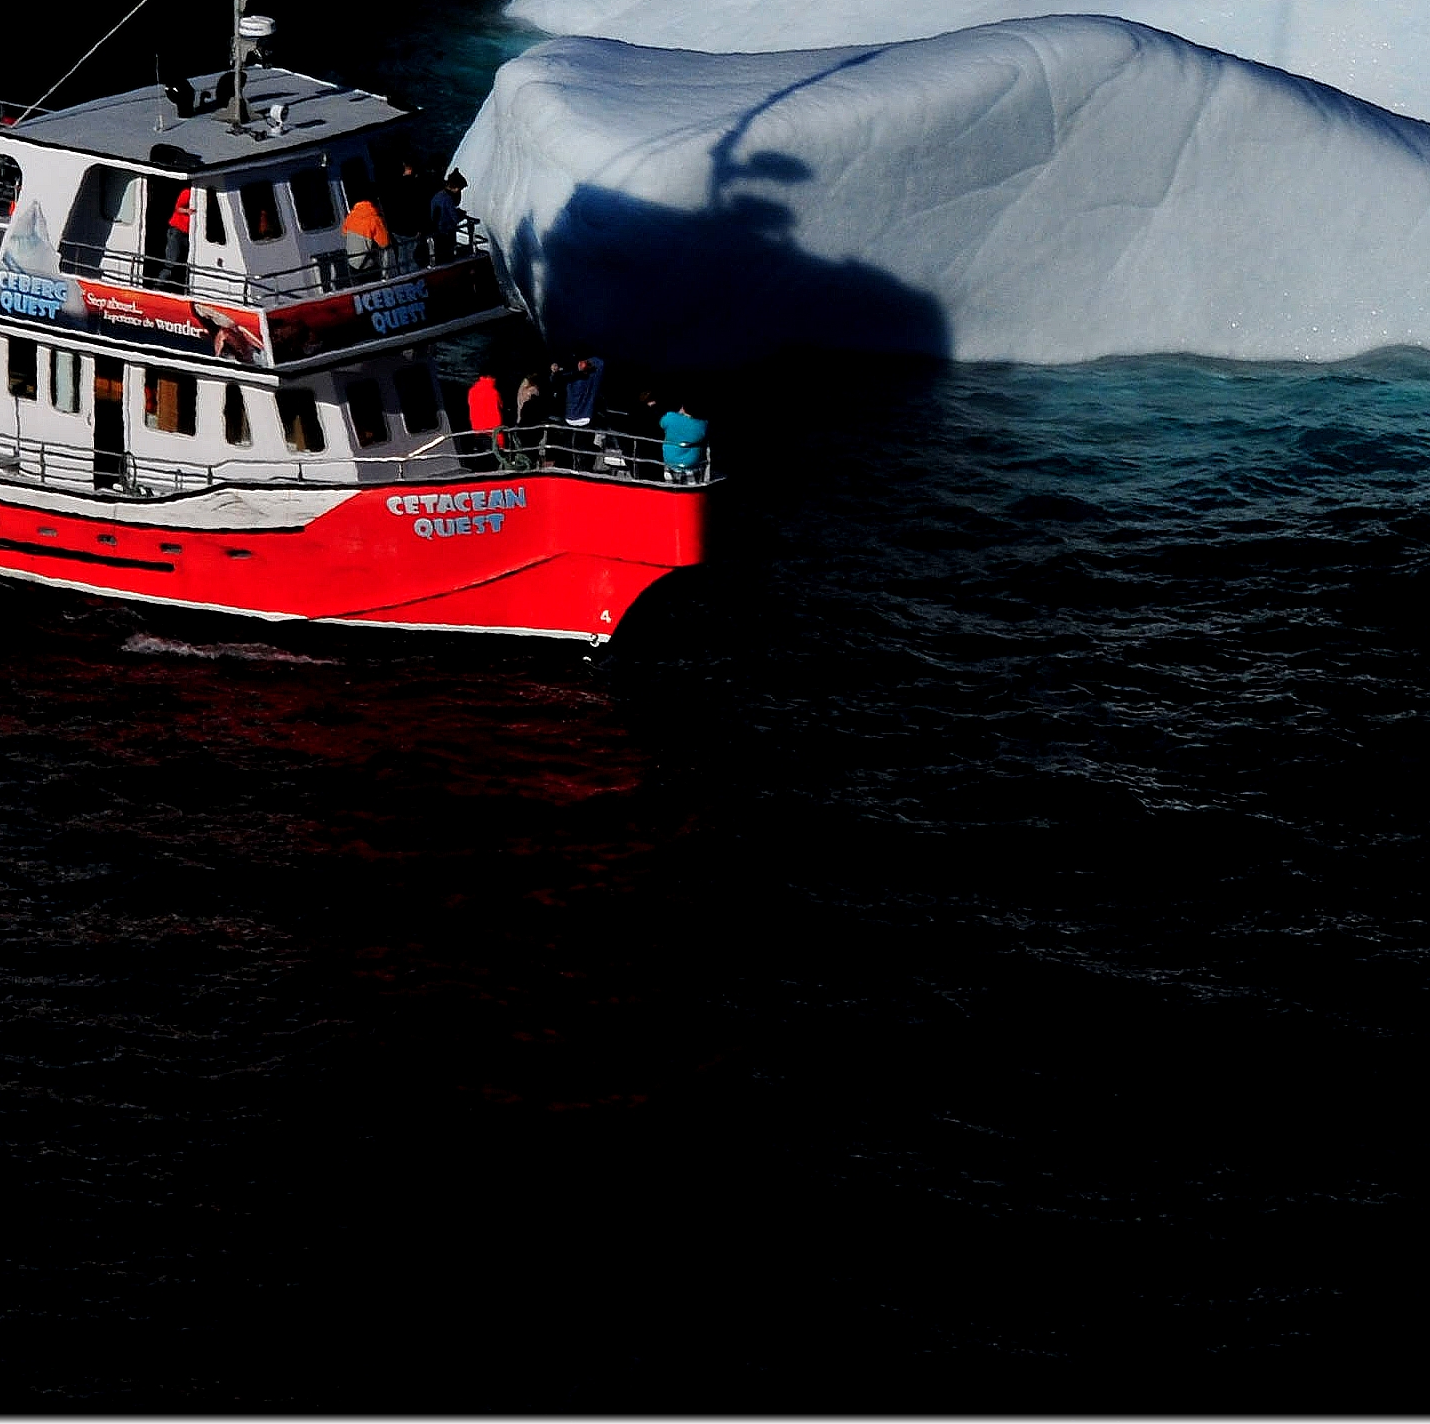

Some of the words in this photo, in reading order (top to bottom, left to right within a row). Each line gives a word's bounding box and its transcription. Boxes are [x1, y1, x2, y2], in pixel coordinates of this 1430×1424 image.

[0, 290, 61, 320] QUEST
[353, 278, 429, 316] ICEBERG
[371, 302, 427, 335] QUEST
[386, 487, 527, 516] CETACEAN
[413, 513, 505, 540] QUEST
[600, 609, 612, 624] 4
